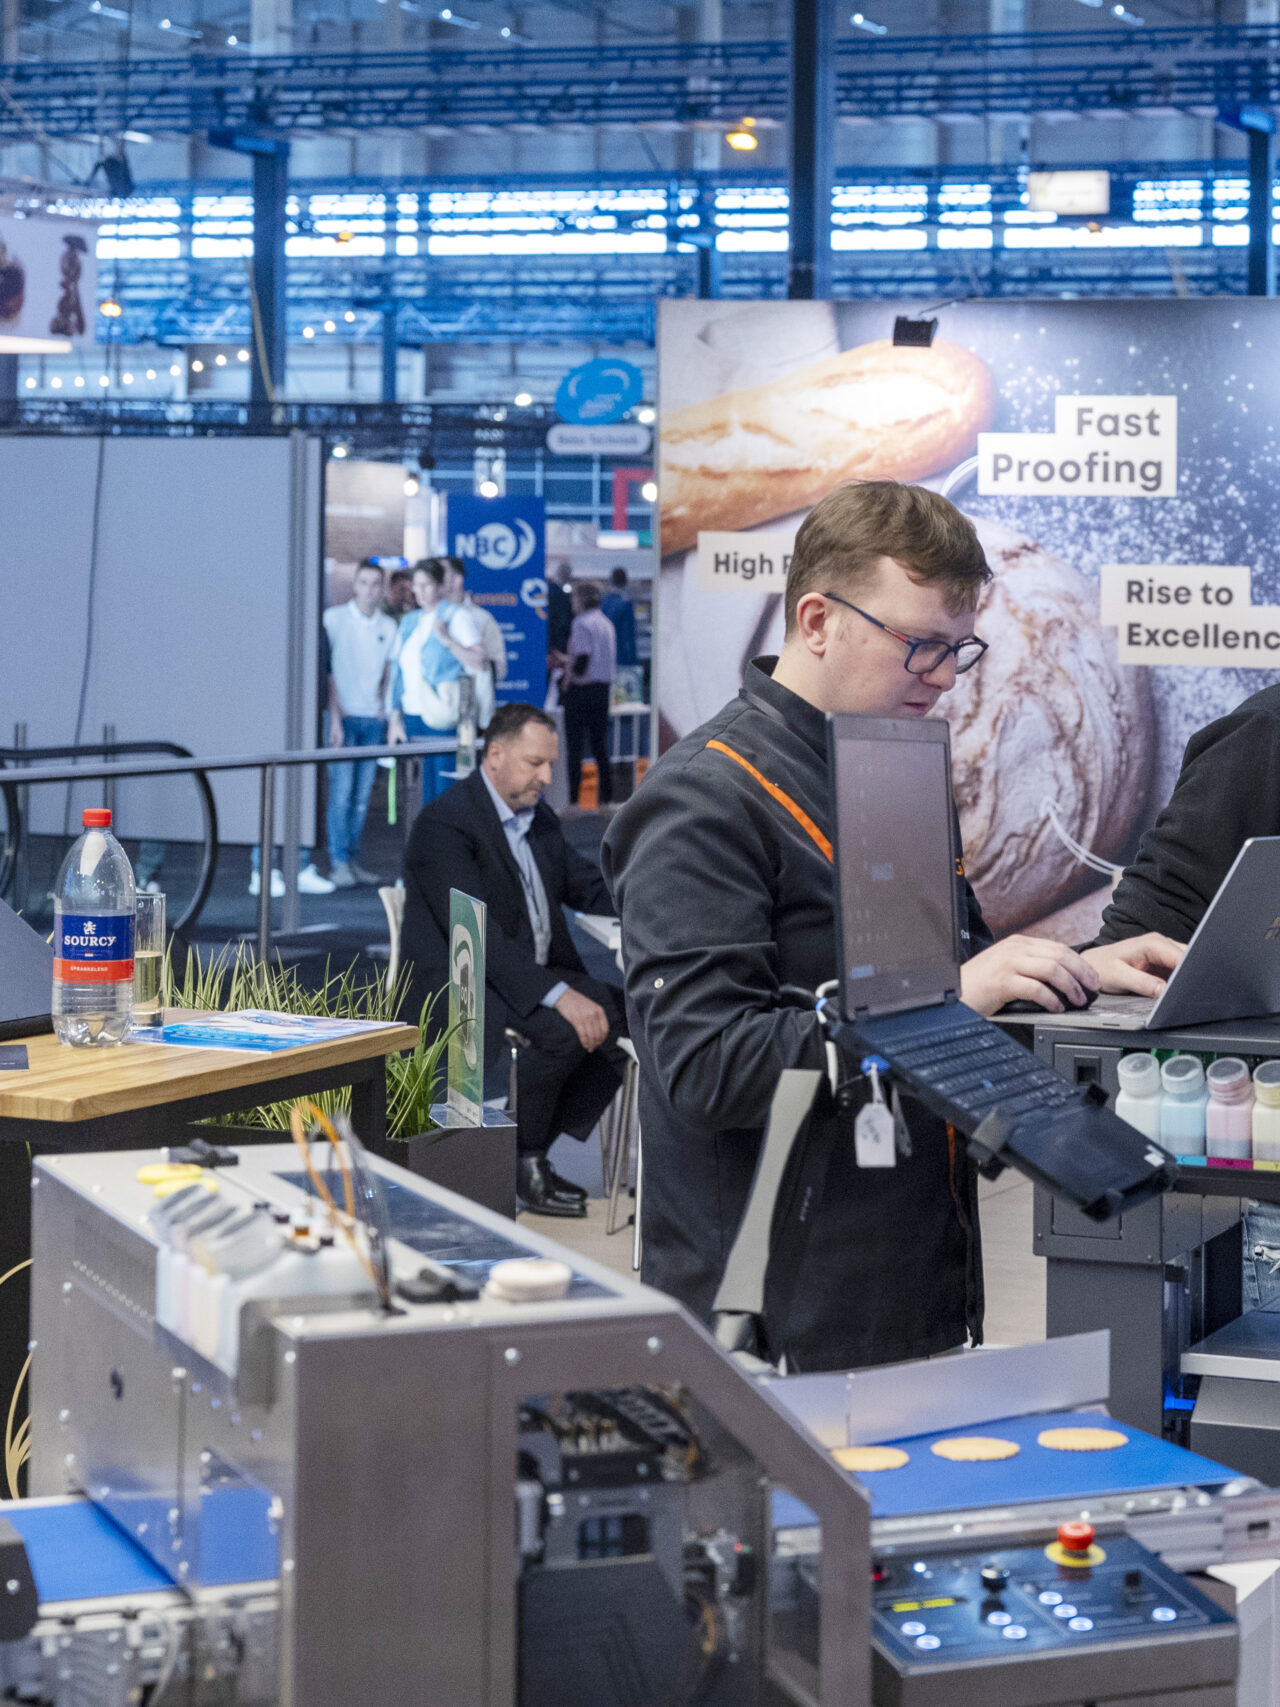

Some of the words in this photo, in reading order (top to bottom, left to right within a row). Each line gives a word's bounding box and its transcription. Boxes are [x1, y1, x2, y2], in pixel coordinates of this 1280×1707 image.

[1076, 407, 1160, 437] Fast
[992, 451, 1162, 492] Proofing
[714, 551, 774, 580] High
[1126, 578, 1192, 605] Rise
[1200, 582, 1234, 606] to
[64, 935, 116, 946] SOURCY
